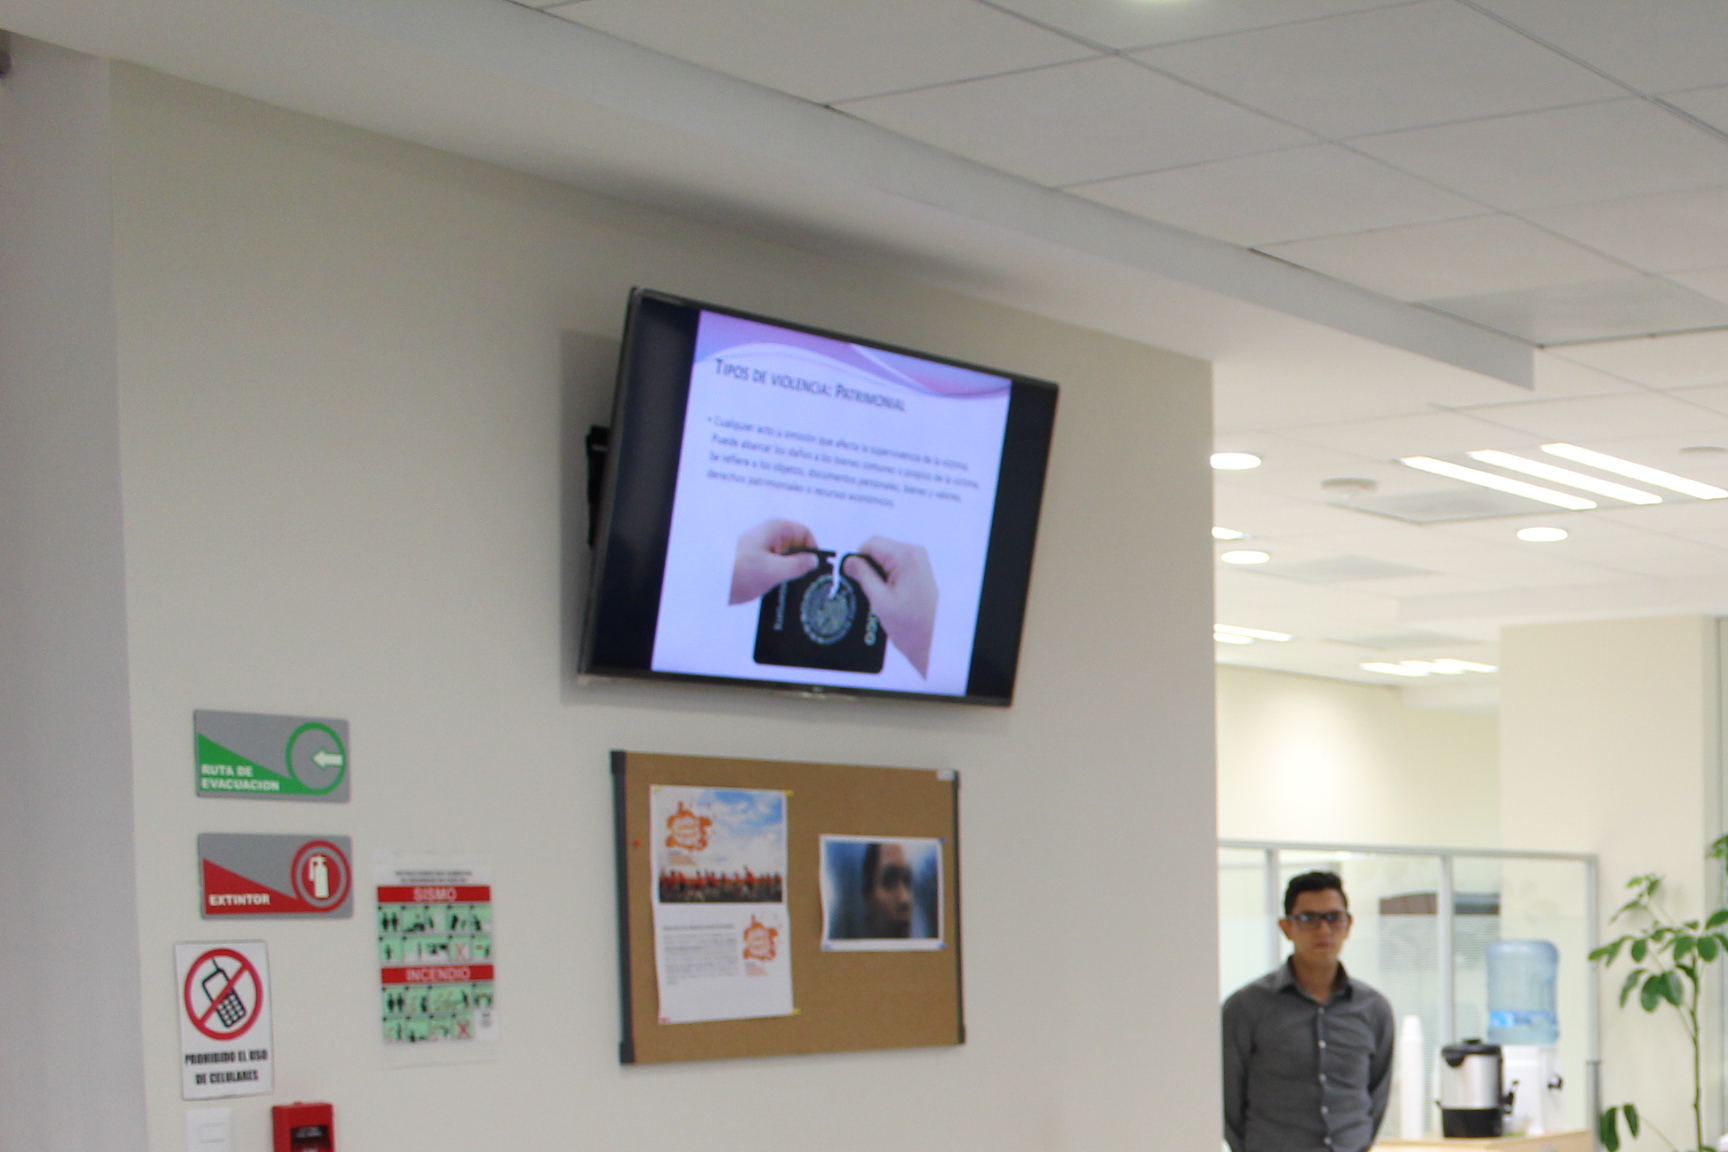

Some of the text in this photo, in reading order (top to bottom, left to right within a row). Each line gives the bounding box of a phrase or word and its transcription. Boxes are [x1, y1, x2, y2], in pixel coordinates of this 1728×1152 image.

[715, 358, 905, 411] TIPOS DE VIOLENCIA: PATRIMONIAL
[713, 415, 753, 432] Cualquier
[712, 432, 738, 447] Puede
[710, 450, 719, 462] Se
[201, 763, 254, 778] RUTA DE
[201, 777, 279, 791] EVACUACION
[210, 893, 271, 906] EXTINTOR
[413, 886, 457, 902] SISMO
[406, 967, 471, 982] INCENDIO
[185, 1048, 268, 1066] PROHIBIDO EL USO
[195, 1070, 259, 1085] DE CELULARES
